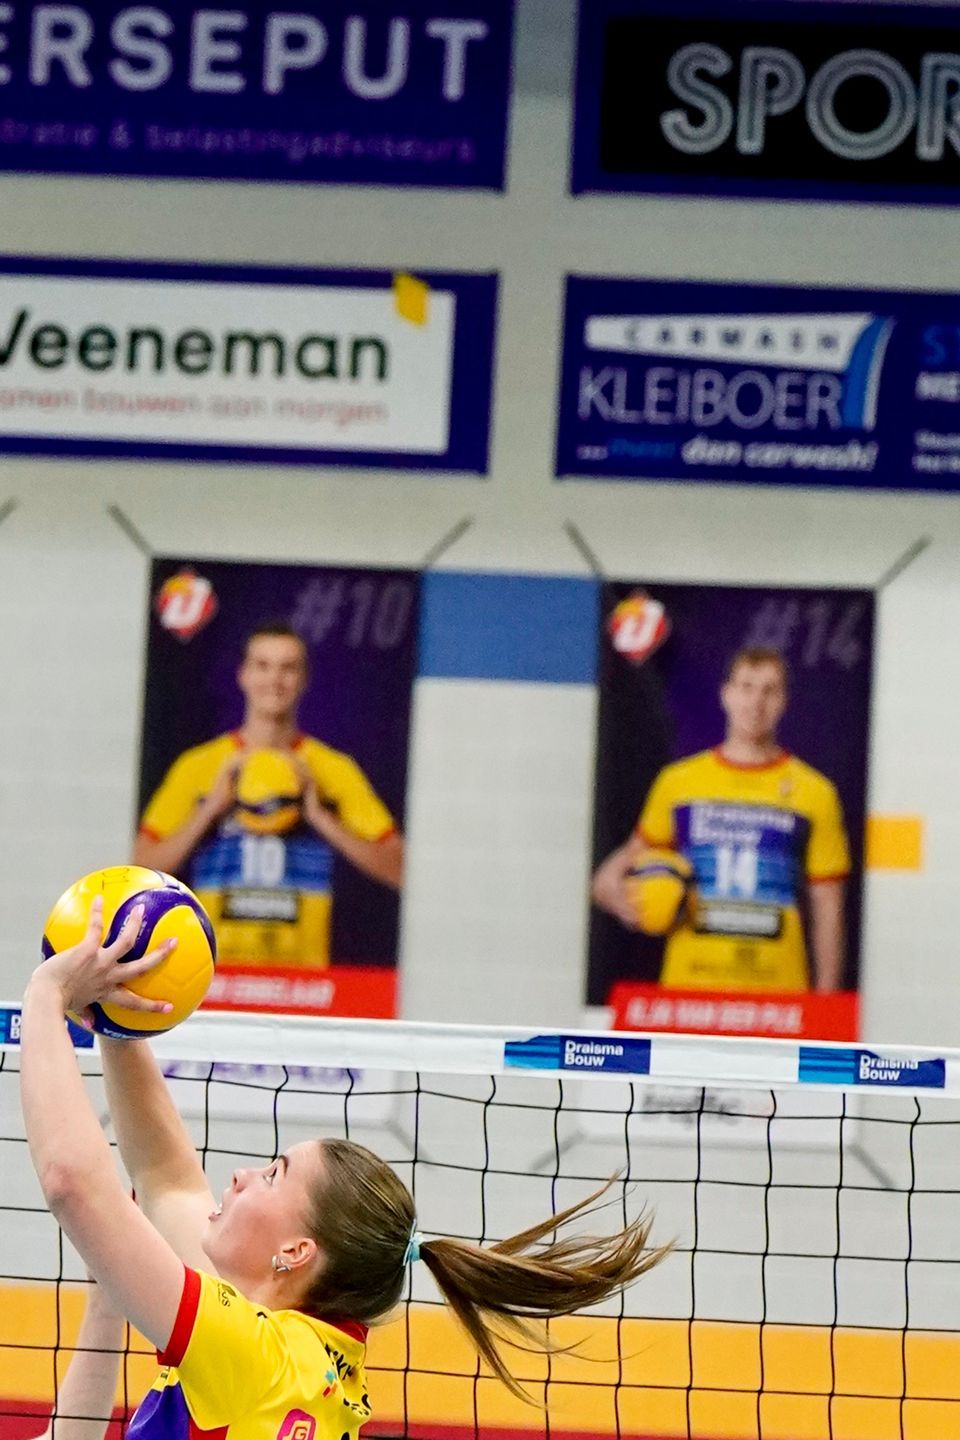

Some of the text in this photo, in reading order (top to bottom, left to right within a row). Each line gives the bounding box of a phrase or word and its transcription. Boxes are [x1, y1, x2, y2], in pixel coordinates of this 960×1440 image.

[577, 366, 843, 431] KLEIBOER
[565, 1040, 623, 1056] Draisma
[564, 1053, 605, 1067] Bouw
[859, 1054, 919, 1071] Draisma
[859, 1067, 901, 1081] Bouw
